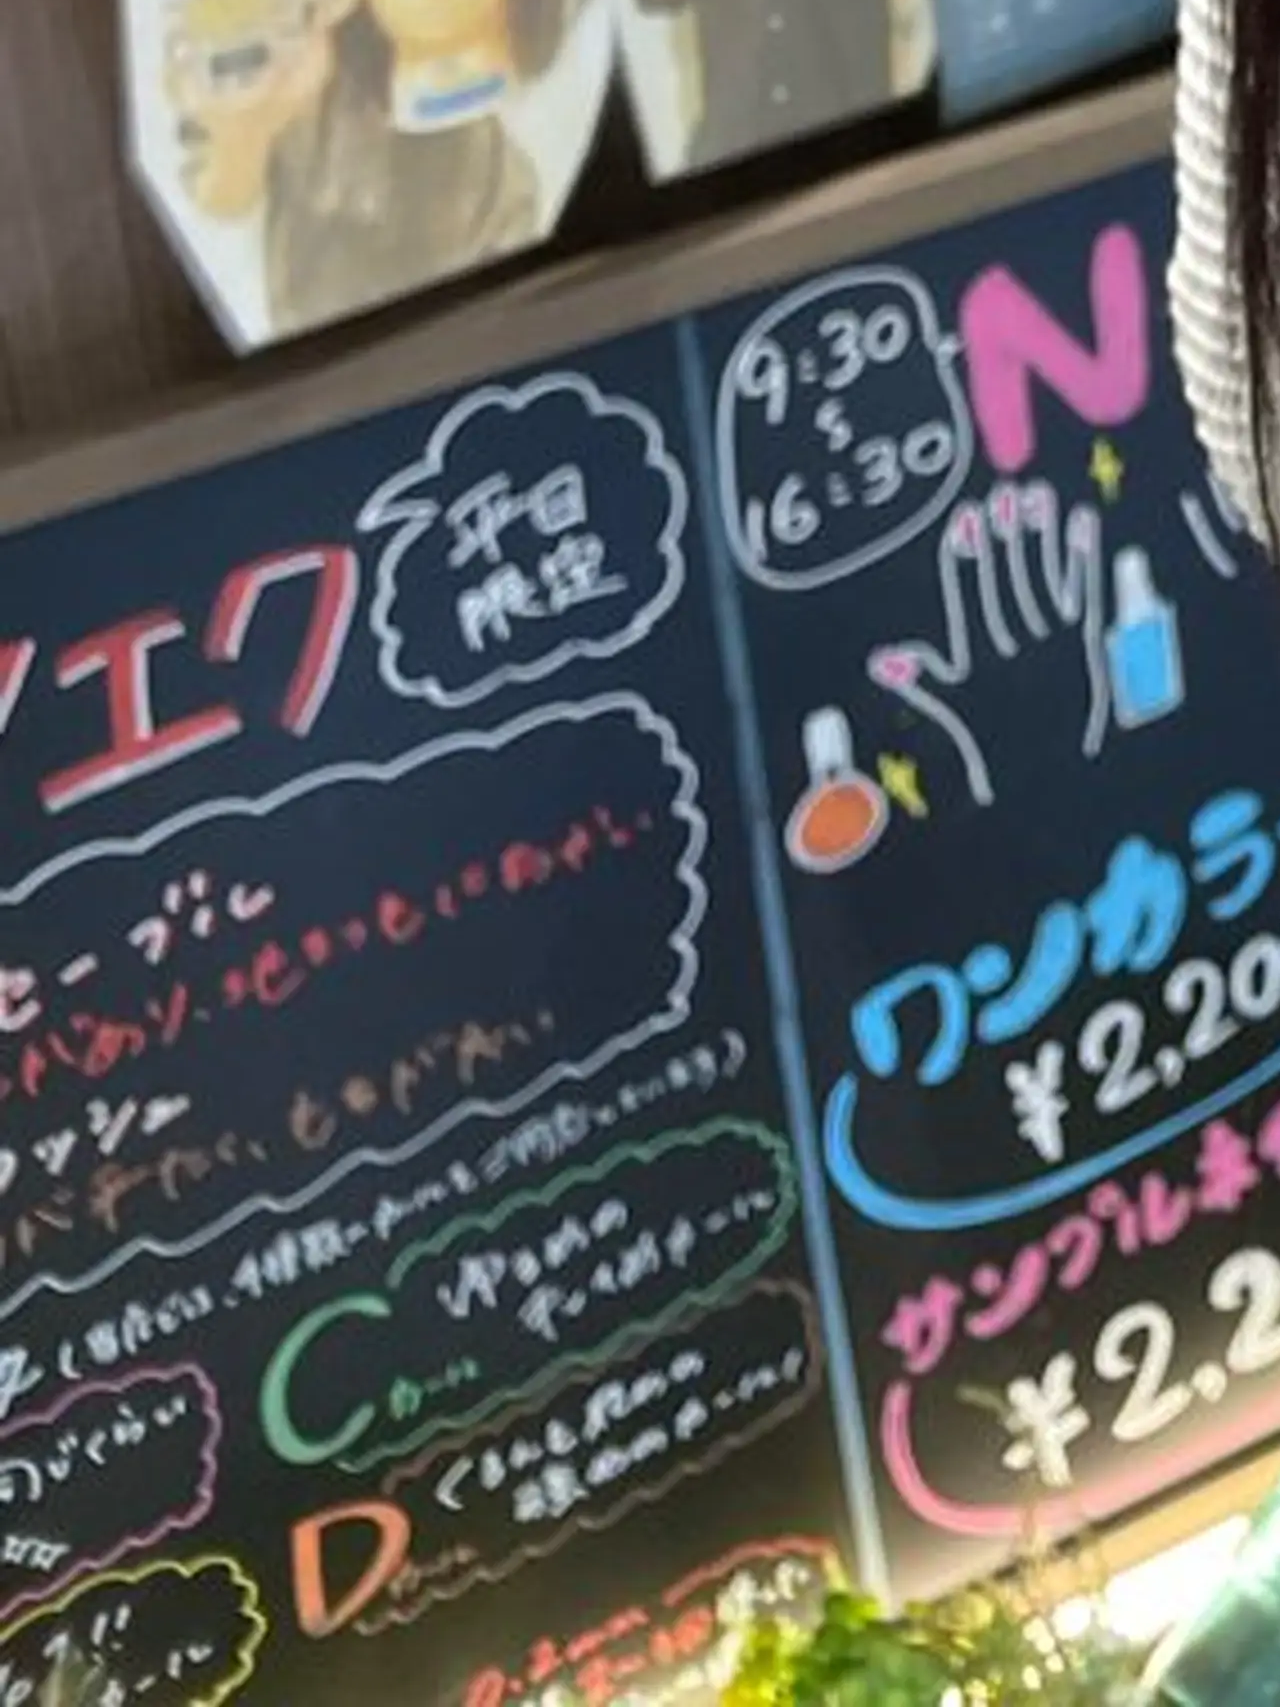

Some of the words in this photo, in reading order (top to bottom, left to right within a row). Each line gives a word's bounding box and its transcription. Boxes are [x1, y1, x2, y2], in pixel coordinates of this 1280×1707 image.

[736, 303, 911, 426] 9:30
[445, 463, 588, 568] 平日
[746, 420, 953, 564] 16:30
[0, 543, 360, 813] エク
[261, 1292, 392, 1465] C
[291, 1499, 412, 1638] D
